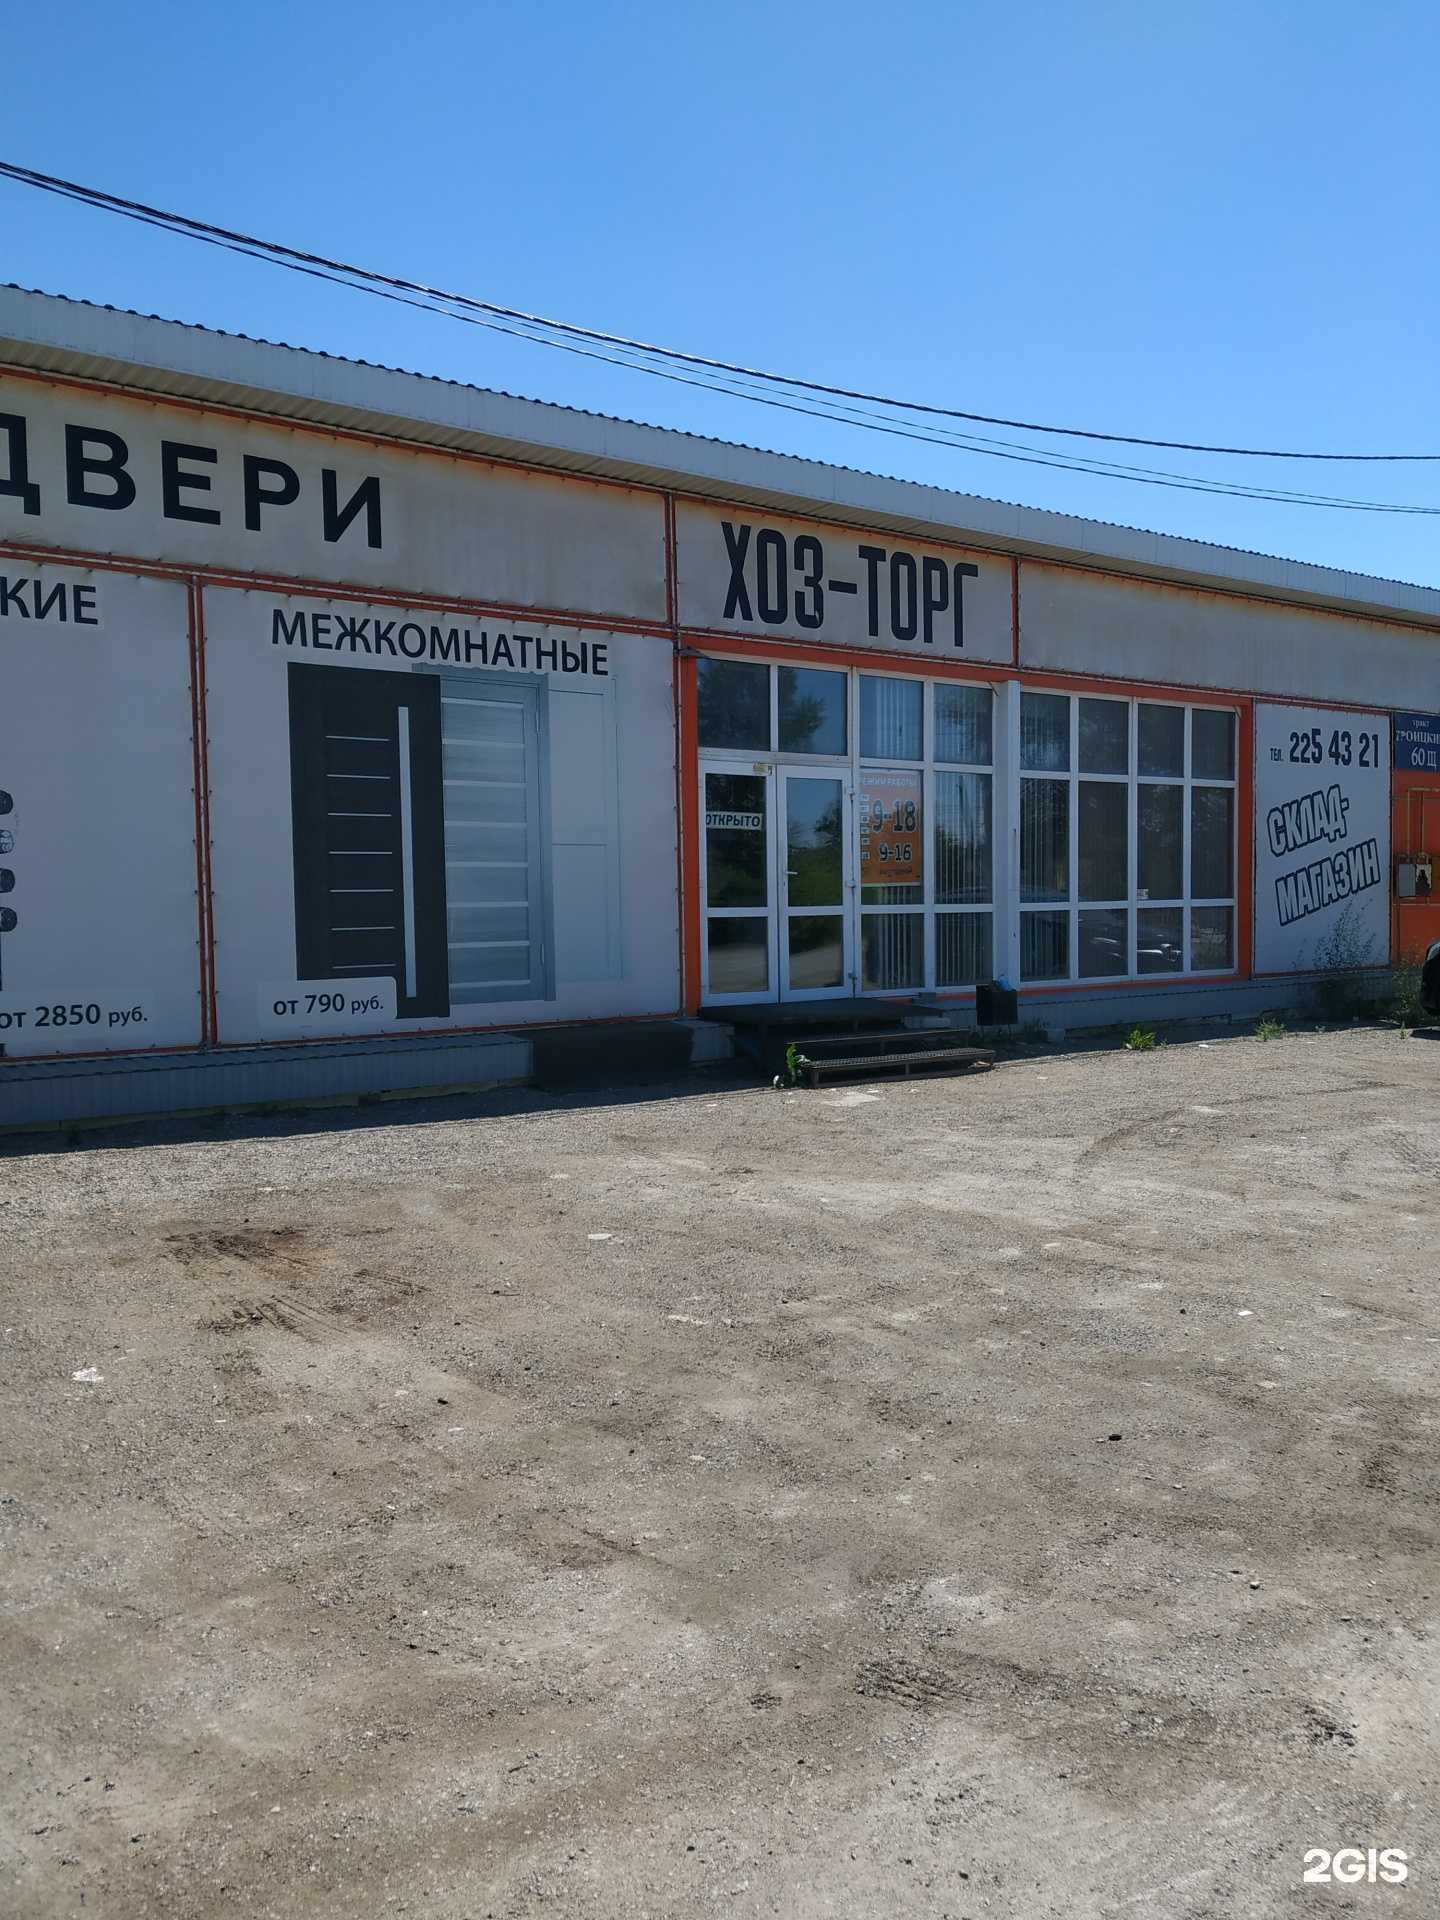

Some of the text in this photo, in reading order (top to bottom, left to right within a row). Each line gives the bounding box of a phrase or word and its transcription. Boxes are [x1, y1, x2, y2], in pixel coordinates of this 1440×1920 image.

[0, 412, 383, 549] ДВЕРИ
[721, 521, 979, 648] ХОЗ-ТОРГ
[272, 608, 609, 676] МЕЖКОМНАТНЫЕ
[1289, 728, 1323, 764] 225
[1328, 730, 1352, 766] 43
[1358, 733, 1379, 768] 21
[706, 813, 760, 827] ОТКРЫТО
[872, 799, 916, 833] 9-18
[1267, 784, 1349, 857] СКЛАД-
[879, 843, 912, 862] 9-16
[1274, 838, 1381, 926] МАГАЗИН
[0, 1003, 148, 1029] от 2850 руб.
[273, 993, 384, 1015] от 790 руб.
